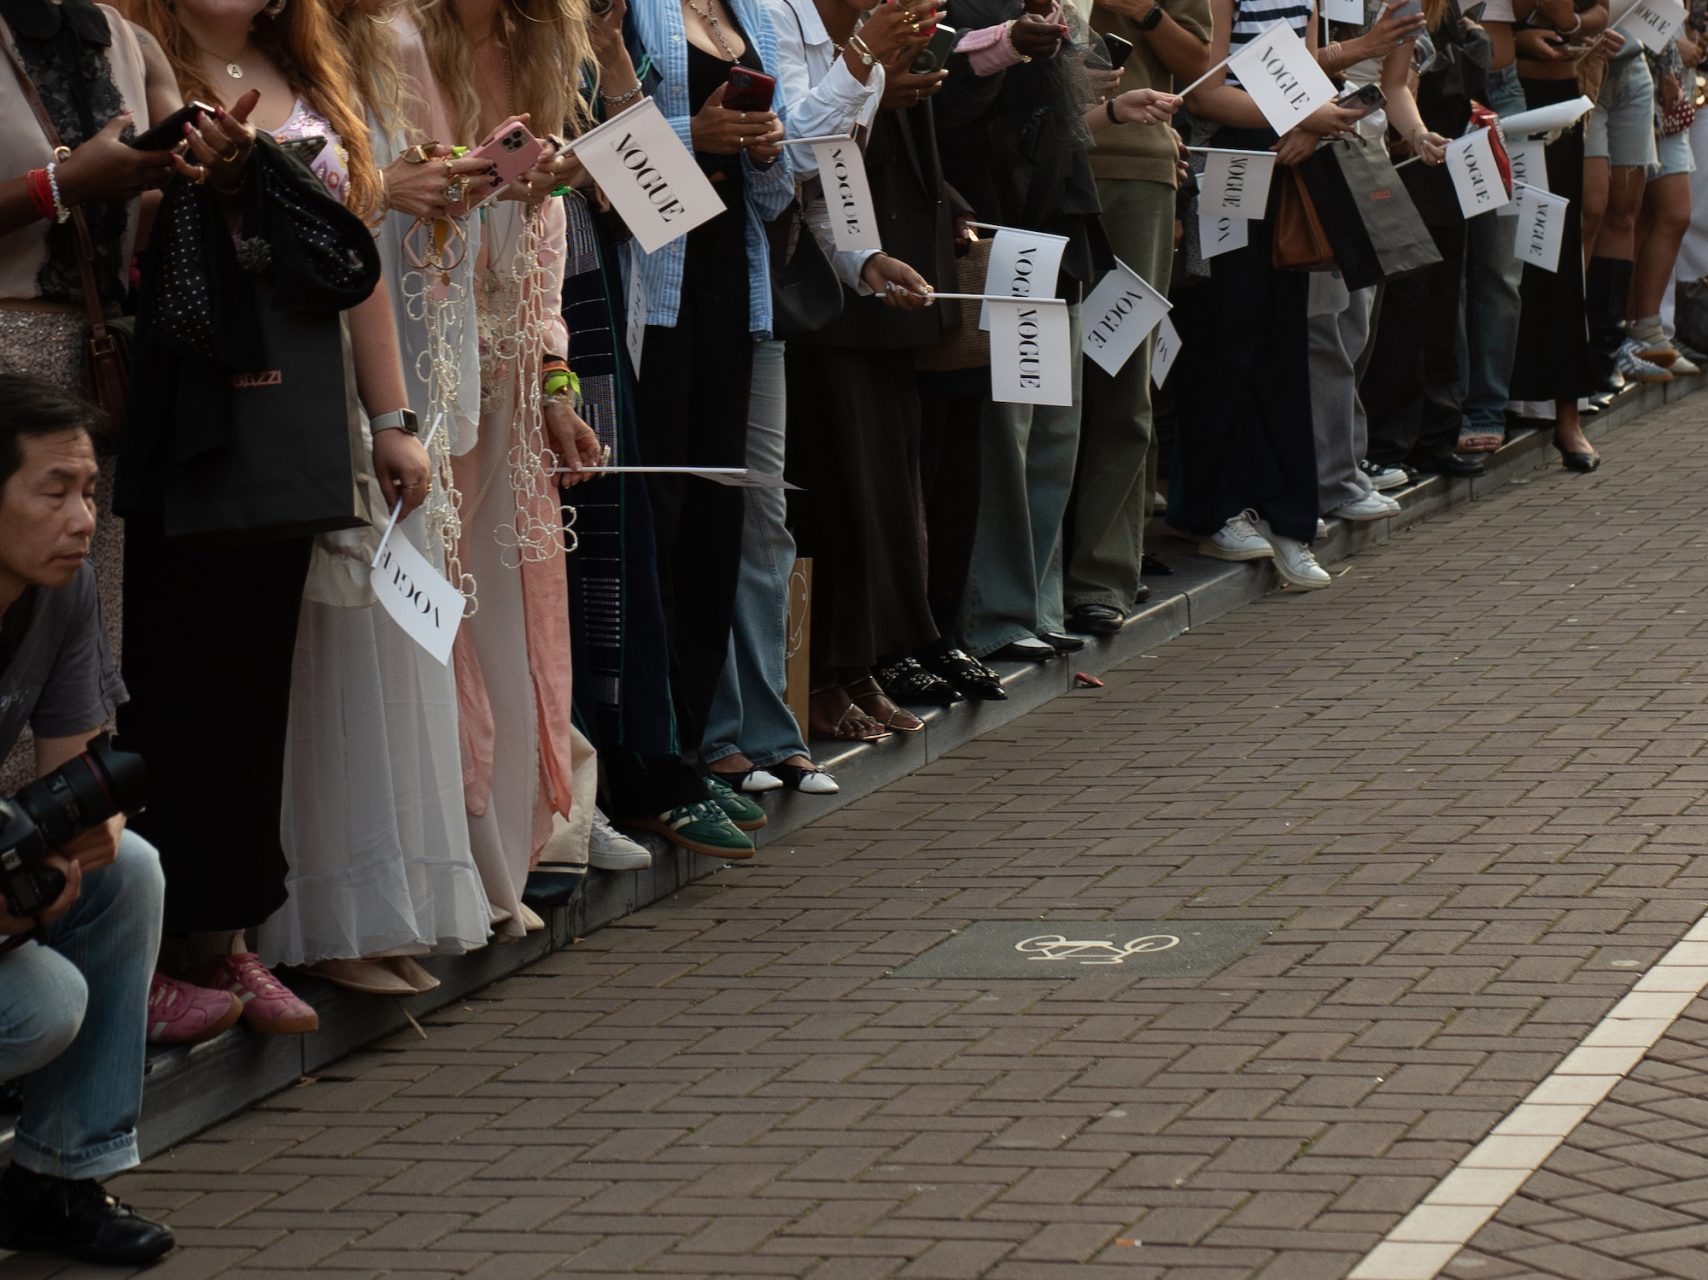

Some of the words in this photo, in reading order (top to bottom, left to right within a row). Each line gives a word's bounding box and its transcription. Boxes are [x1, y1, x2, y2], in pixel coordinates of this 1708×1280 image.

[1256, 45, 1310, 111] VOGUE
[610, 131, 686, 223] VOGUE
[829, 147, 861, 235] VOGUE
[1222, 156, 1249, 208] VOGUE
[1462, 142, 1490, 204] VOGUE
[1529, 202, 1549, 257] VOGUE
[1016, 307, 1040, 388] VOGUE
[1087, 290, 1143, 349] VOGUE
